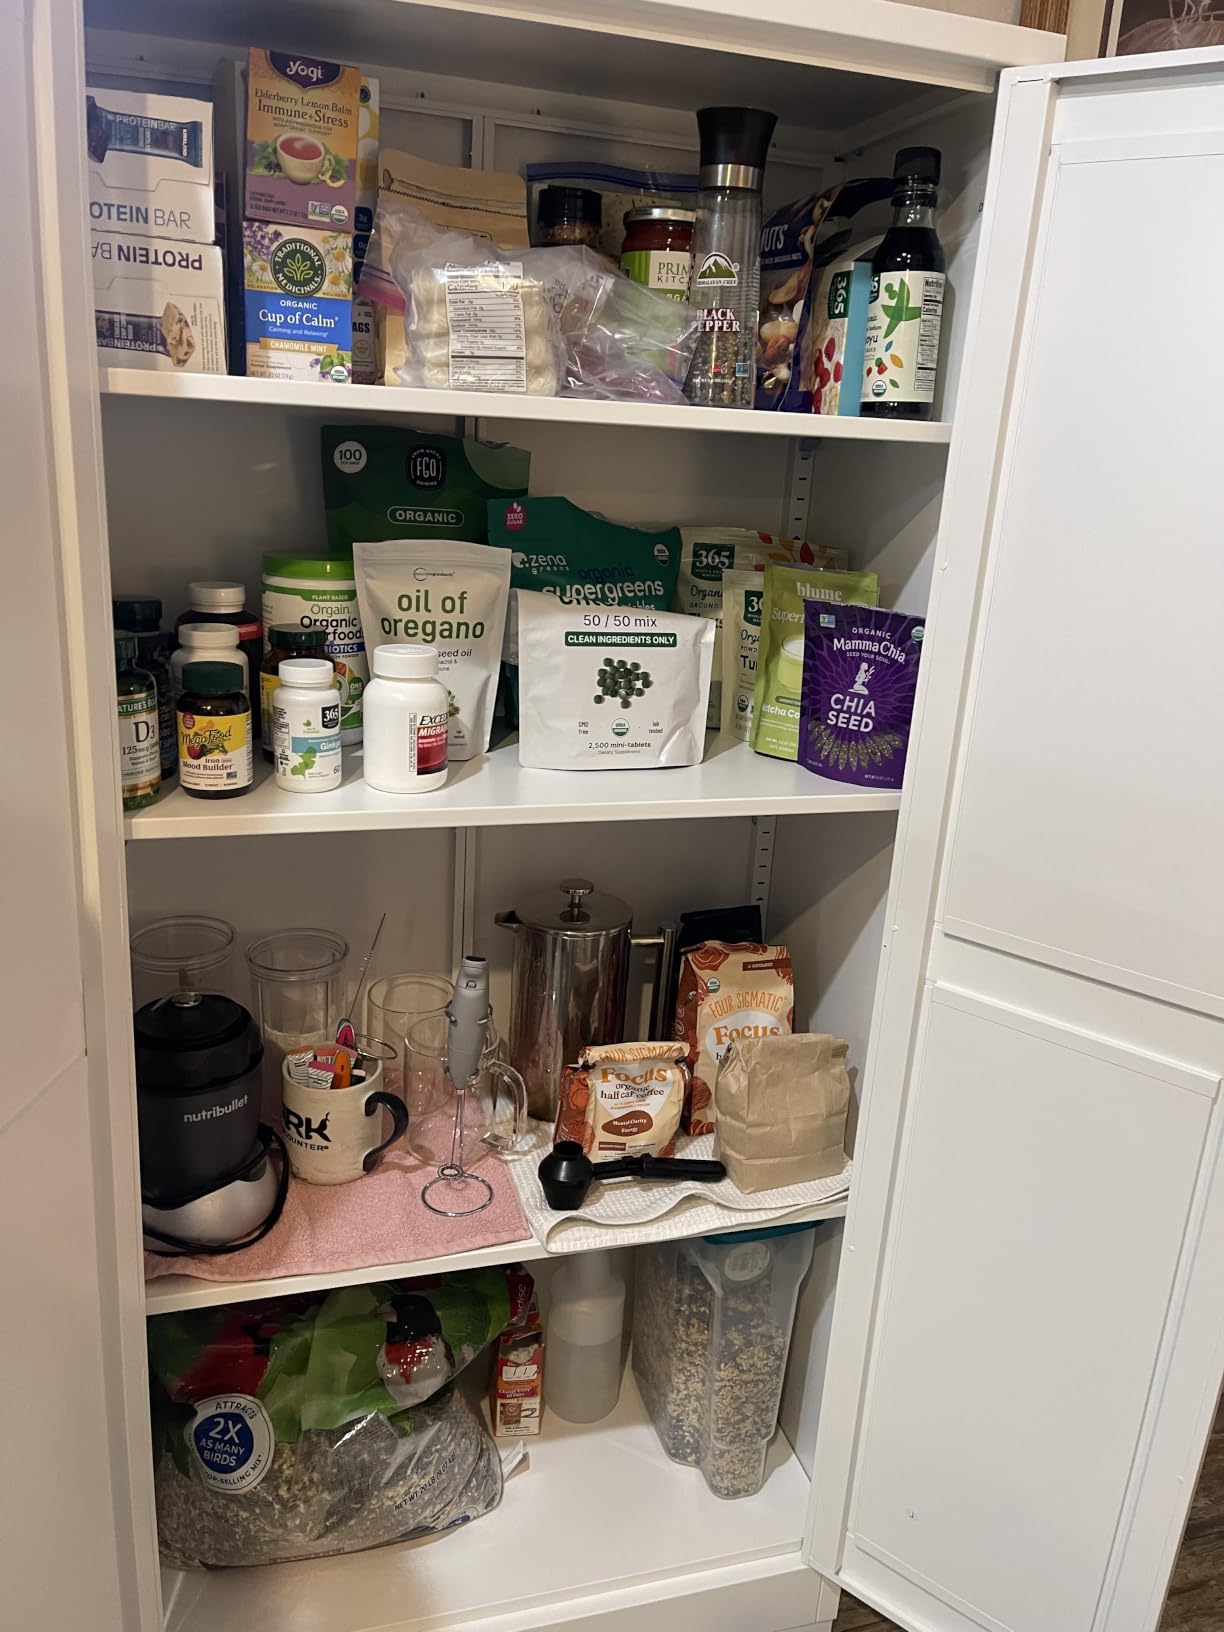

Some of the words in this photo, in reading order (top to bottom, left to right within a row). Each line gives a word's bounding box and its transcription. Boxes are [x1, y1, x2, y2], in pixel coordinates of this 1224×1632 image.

[286, 60, 323, 82] yogi
[255, 88, 299, 106] Elderberry
[301, 97, 330, 111] Lemon
[332, 103, 353, 116] Balm
[154, 208, 191, 230] BAR
[117, 244, 203, 271] PROTEIN
[274, 242, 322, 268] TRADITIONAL
[833, 276, 847, 315] 365
[279, 299, 318, 310] ORGANIC
[259, 308, 285, 326] Cup
[287, 312, 302, 325] of
[696, 308, 736, 320] BLACK
[268, 325, 292, 335] Calming
[292, 328, 303, 336] and
[697, 320, 741, 332] EPPER
[270, 340, 309, 352] CHAMOMILE
[310, 344, 328, 353] MINT
[338, 448, 362, 461] 100
[395, 510, 457, 524] ORGANIC
[506, 512, 524, 520] ZERO
[528, 553, 568, 568] zena
[695, 548, 730, 569] 365
[531, 565, 570, 575] greens
[575, 563, 635, 584] organic
[796, 581, 843, 601] blume
[397, 589, 431, 613] oil
[441, 591, 468, 615] of
[300, 615, 358, 630] Organic
[583, 614, 601, 627] 50
[605, 614, 609, 628] /
[613, 615, 631, 627] 50
[634, 615, 657, 627] mix
[380, 616, 485, 644] oregano
[852, 627, 892, 639] ORGANIC
[567, 634, 596, 643] CLEAN
[597, 635, 651, 644] INGREDIENTS
[652, 636, 675, 645] ONLY
[460, 649, 472, 658] oil
[830, 693, 876, 717] CHIA
[323, 708, 339, 722] 365
[826, 710, 874, 733] SEED
[180, 724, 233, 750] MegaFood
[588, 742, 609, 750] 2,500
[183, 760, 201, 770] Blood
[202, 763, 233, 771] Builder
[708, 995, 735, 1019] FOUR
[736, 991, 784, 1013] SIGMATIC
[712, 1025, 780, 1046] Focus
[600, 1067, 668, 1086] Focus
[600, 1090, 619, 1100] half
[615, 1083, 650, 1094] organic
[183, 1094, 249, 1123] nutribullet
[215, 1400, 257, 1420] ATTRACTS
[208, 1417, 242, 1444] 2X
[199, 1438, 213, 1449] AS
[214, 1441, 245, 1455] MANY
[203, 1450, 237, 1467] BIRDS
[394, 1498, 408, 1511] NET
[408, 1491, 419, 1502] WT
[419, 1483, 428, 1495] 20
[427, 1475, 436, 1487] LB
